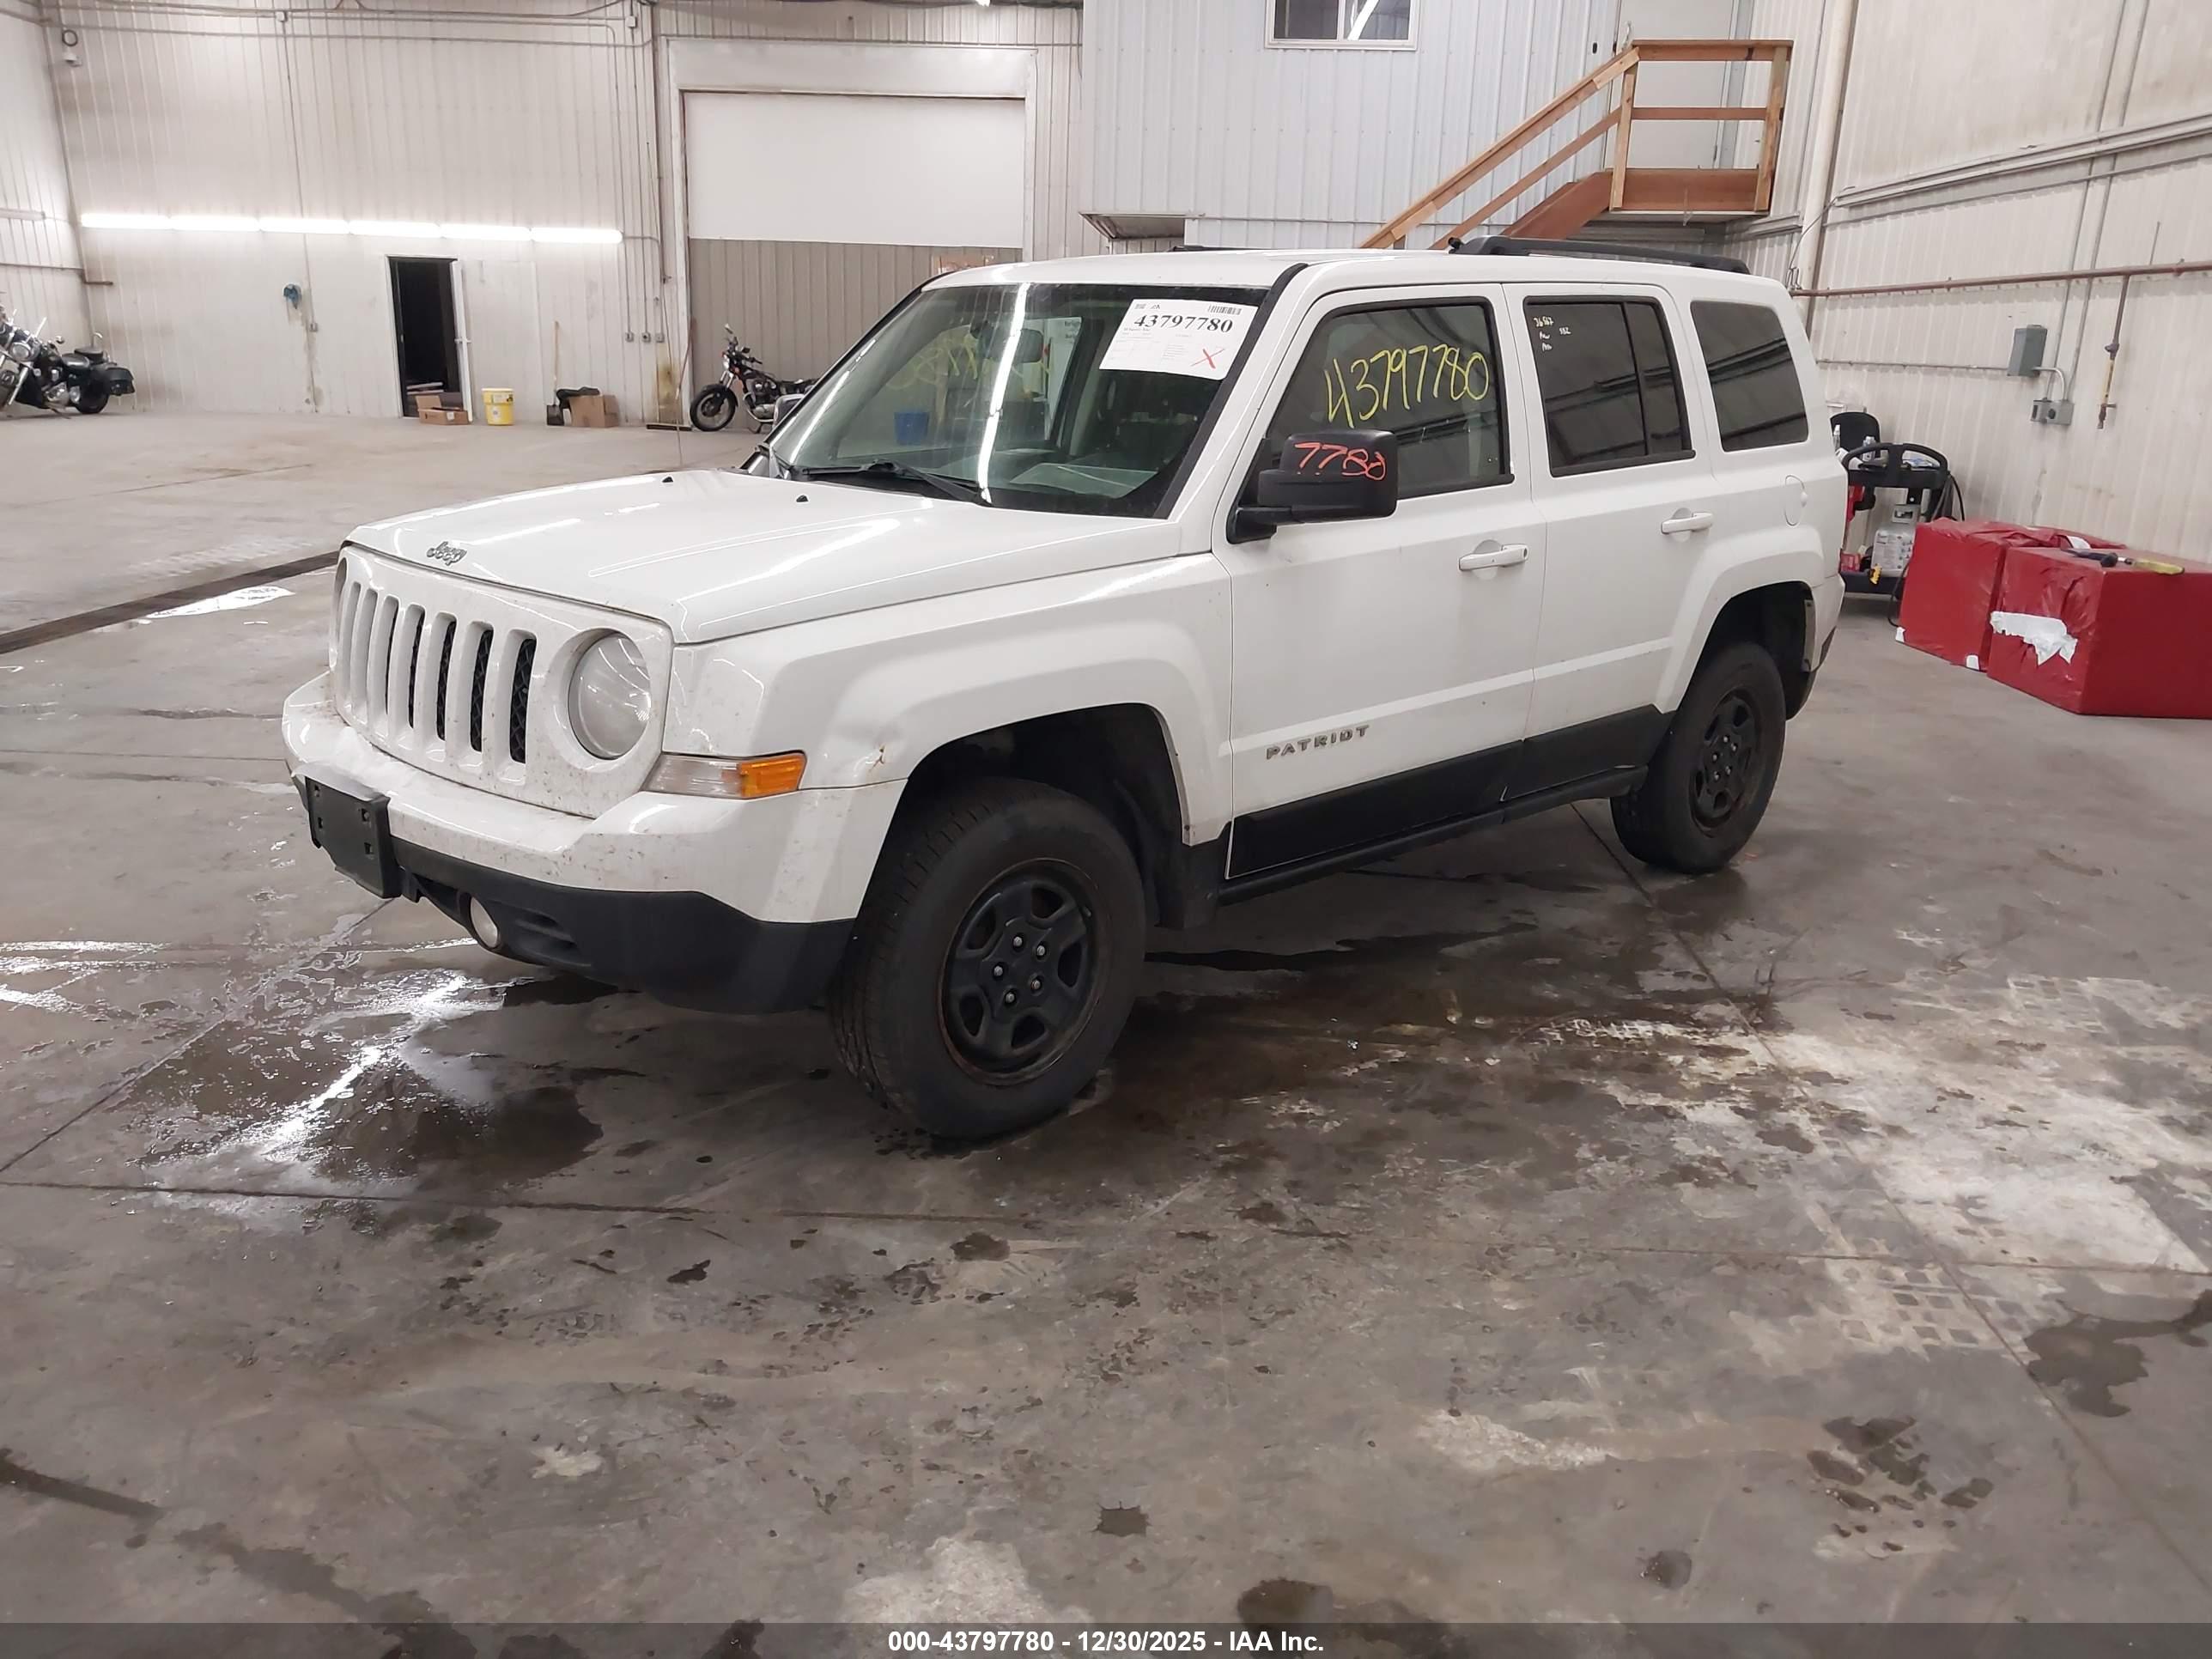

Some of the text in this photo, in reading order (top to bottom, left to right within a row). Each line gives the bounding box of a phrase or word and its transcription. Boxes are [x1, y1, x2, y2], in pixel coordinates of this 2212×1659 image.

[1133, 314, 1233, 333] 43797780
[1323, 343, 1490, 429] 43797780
[1294, 441, 1388, 481] 7780
[426, 540, 469, 567] Jeep
[1266, 724, 1370, 761] PATRIOT
